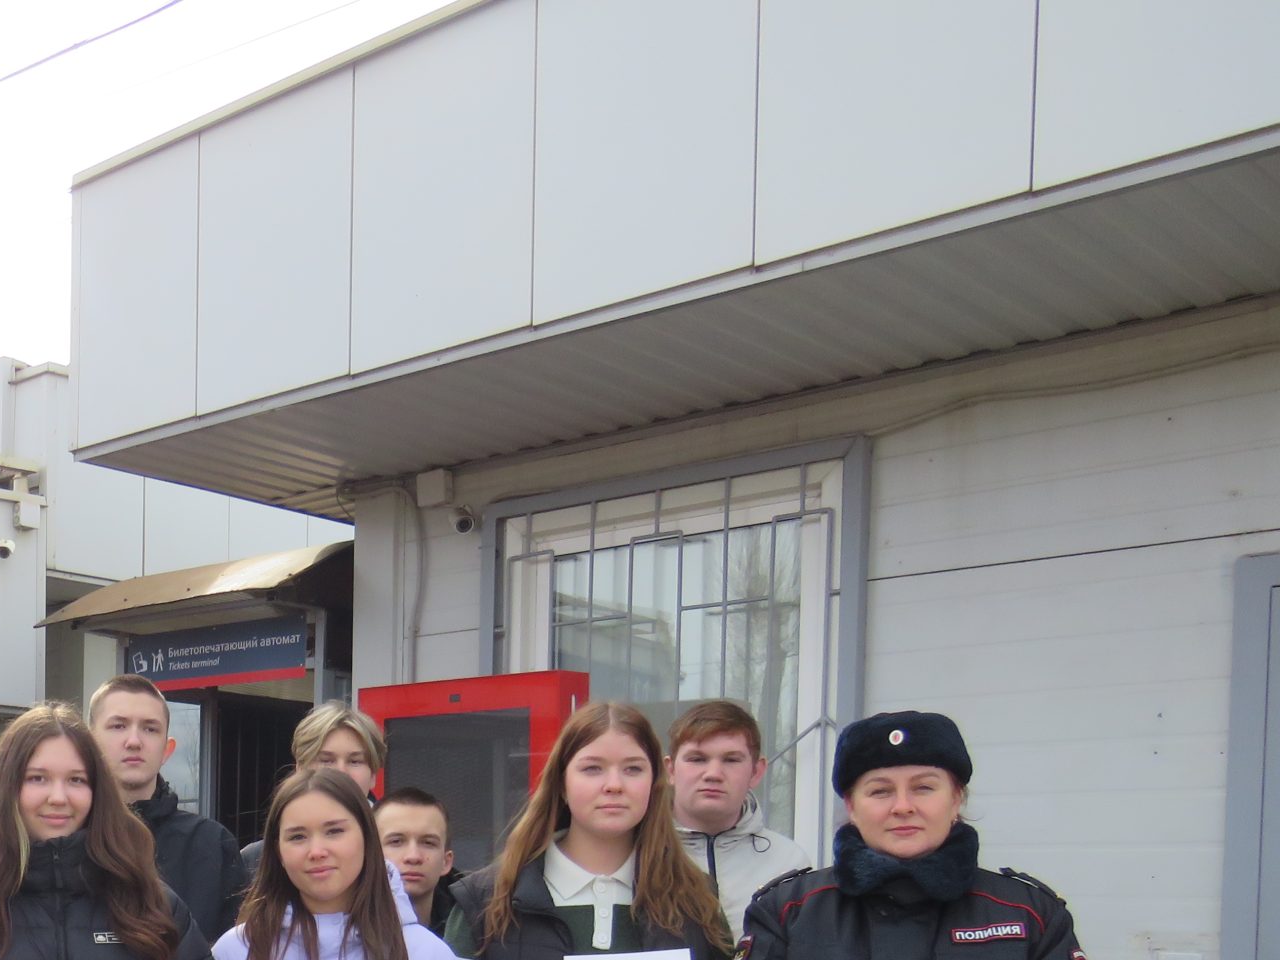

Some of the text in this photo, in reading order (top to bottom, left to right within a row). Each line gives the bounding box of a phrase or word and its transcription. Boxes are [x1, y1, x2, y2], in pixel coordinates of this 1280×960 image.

[168, 633, 301, 658] Билетопечатающий автомат
[169, 656, 220, 671] Tickets terminal
[955, 925, 1022, 940] ПОЛИЦИЯ
